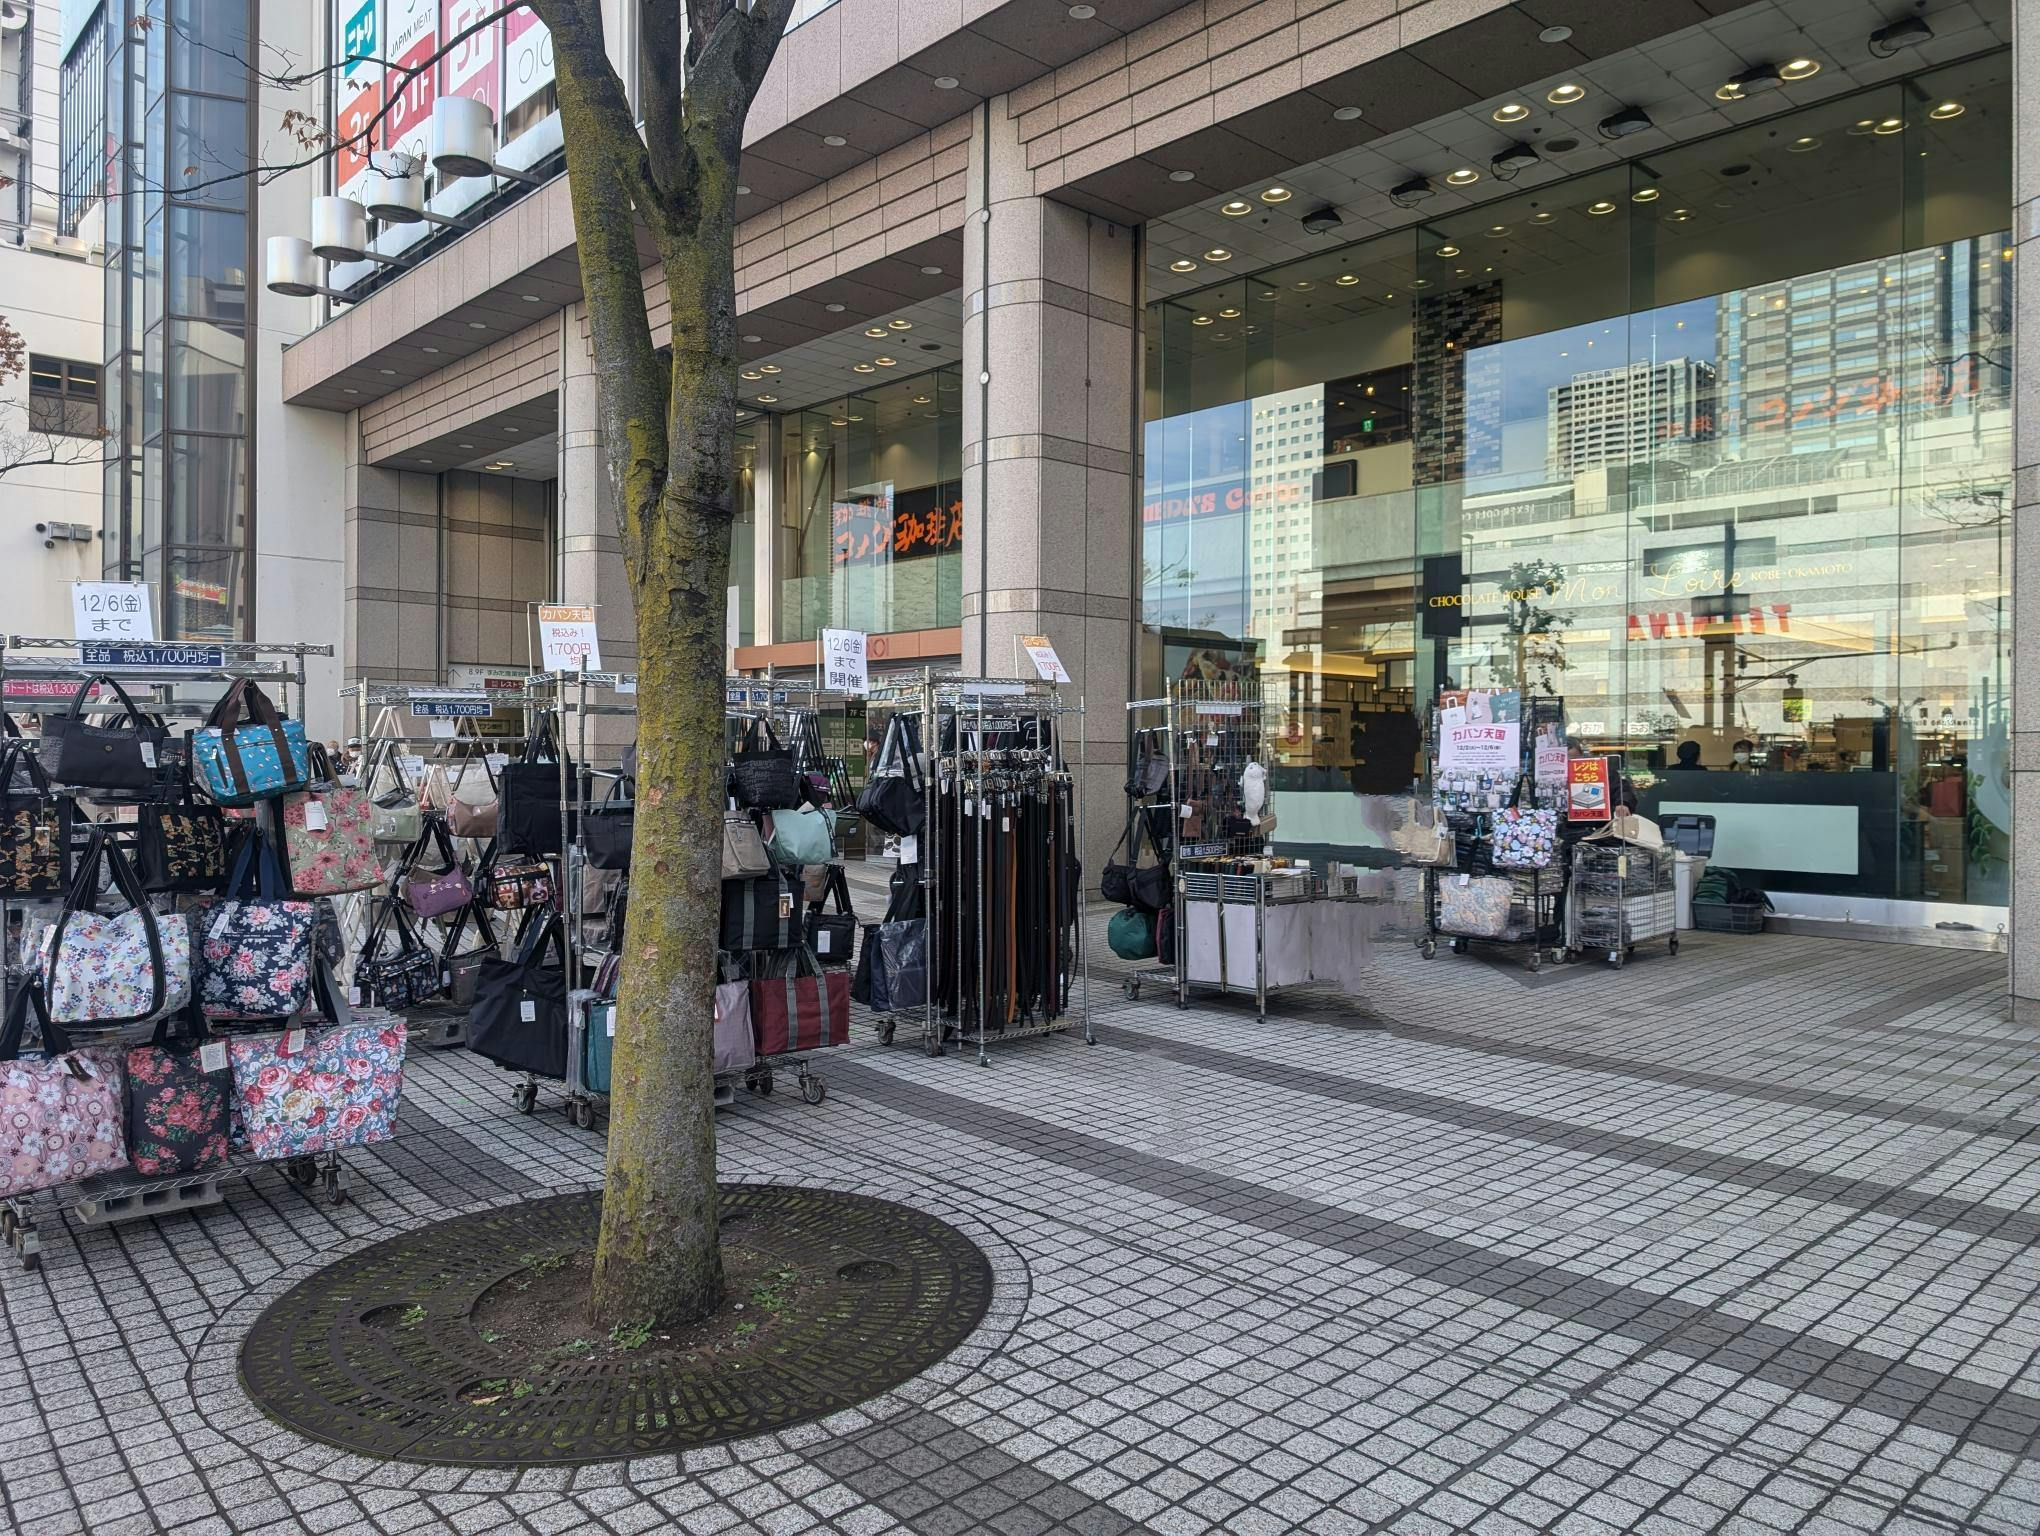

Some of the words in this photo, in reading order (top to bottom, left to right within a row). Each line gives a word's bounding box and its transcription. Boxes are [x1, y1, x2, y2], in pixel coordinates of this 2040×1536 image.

[347, 10, 373, 57] ニトリ
[390, 26, 412, 58] JAPAN
[1429, 592, 1501, 608] CHOCOLATE
[1503, 588, 1542, 602] HOUSE
[1545, 577, 1625, 605] Mon
[1645, 562, 1746, 597] Loire
[80, 594, 142, 613] 12/6(金)
[543, 609, 591, 621] カバン天国
[91, 618, 132, 632] まで
[86, 648, 111, 662] 全品
[834, 656, 856, 669] まで
[830, 672, 863, 689] 開催
[414, 704, 429, 715] 全品
[1452, 728, 1506, 742] カバン天国
[1574, 762, 1599, 772] レジは
[1574, 773, 1599, 782] こちら
